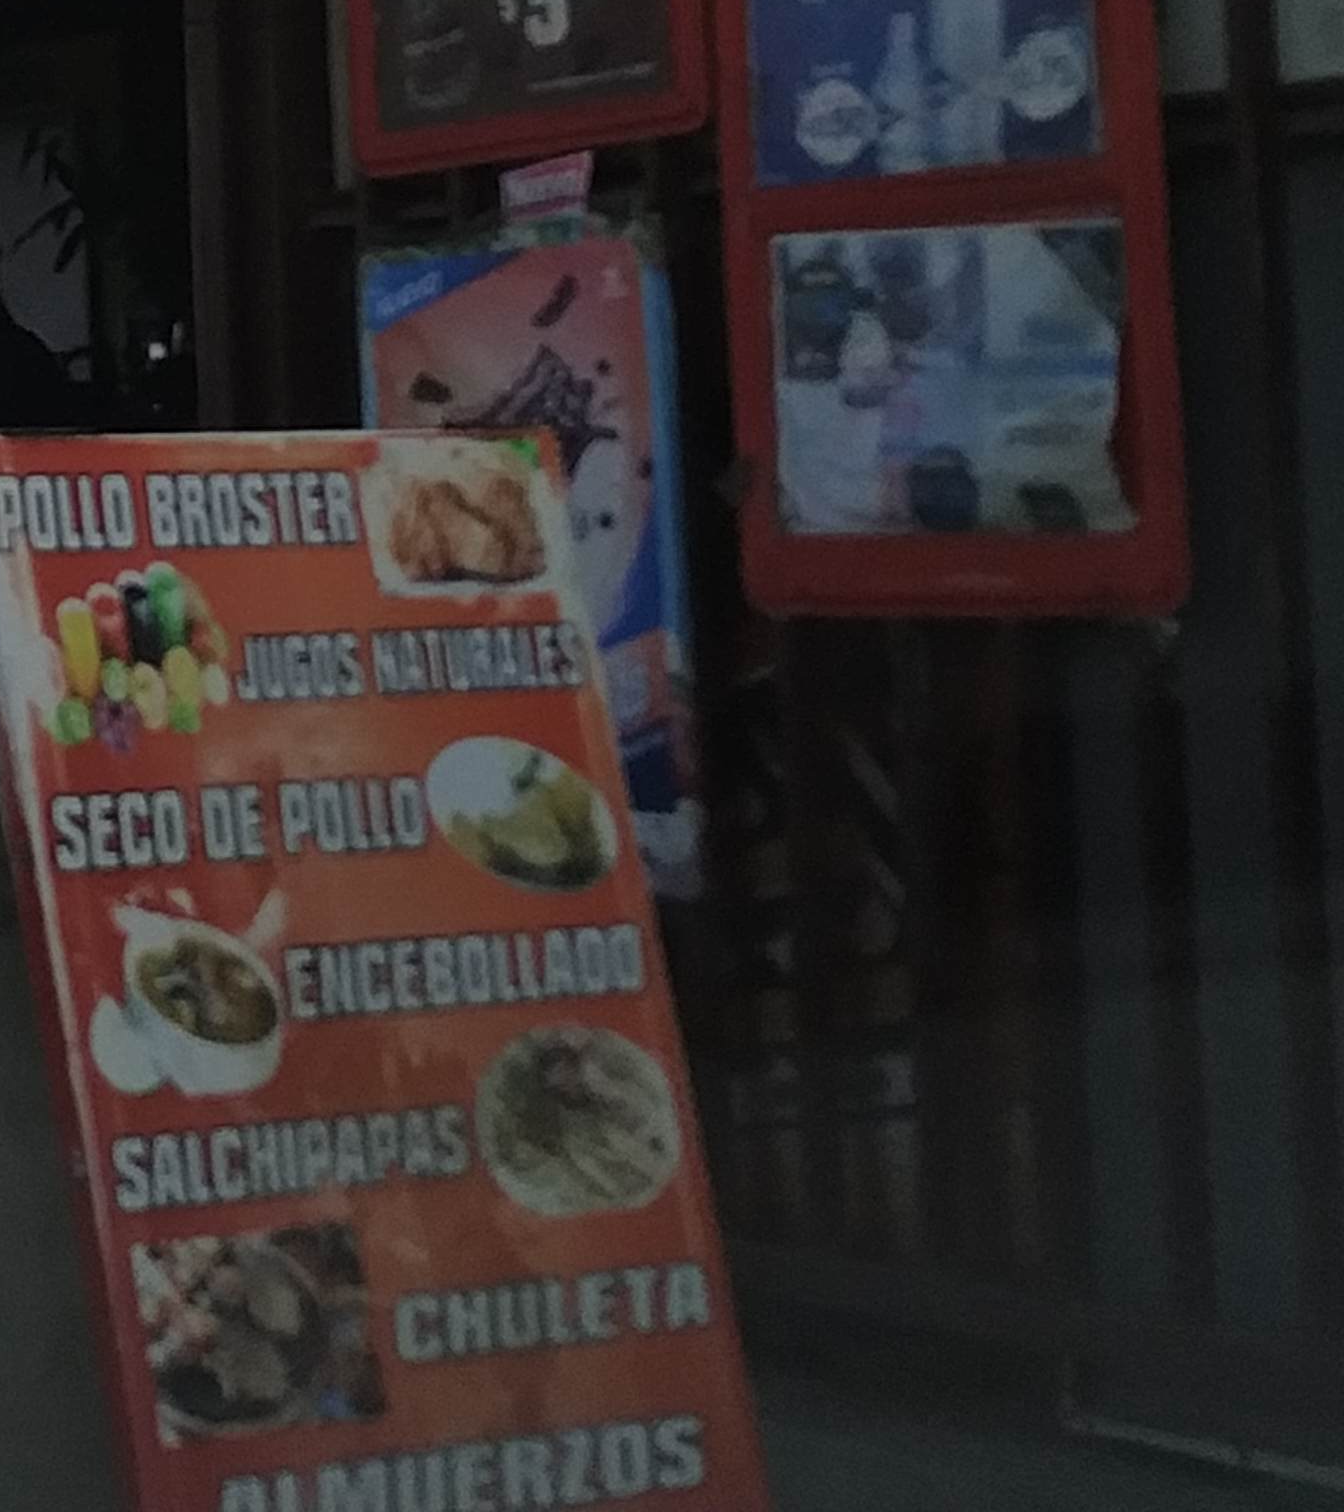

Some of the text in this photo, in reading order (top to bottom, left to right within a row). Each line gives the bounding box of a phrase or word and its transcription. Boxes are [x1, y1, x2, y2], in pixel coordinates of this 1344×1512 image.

[146, 470, 361, 548] BROSTER
[237, 619, 588, 701] JUGOS NATURALES
[50, 776, 428, 873] SECO DE POLLO
[284, 922, 644, 1021] ENCEBOLLADO
[113, 1102, 473, 1214] SALCHIPAPAS
[393, 1261, 711, 1364] CHULETA
